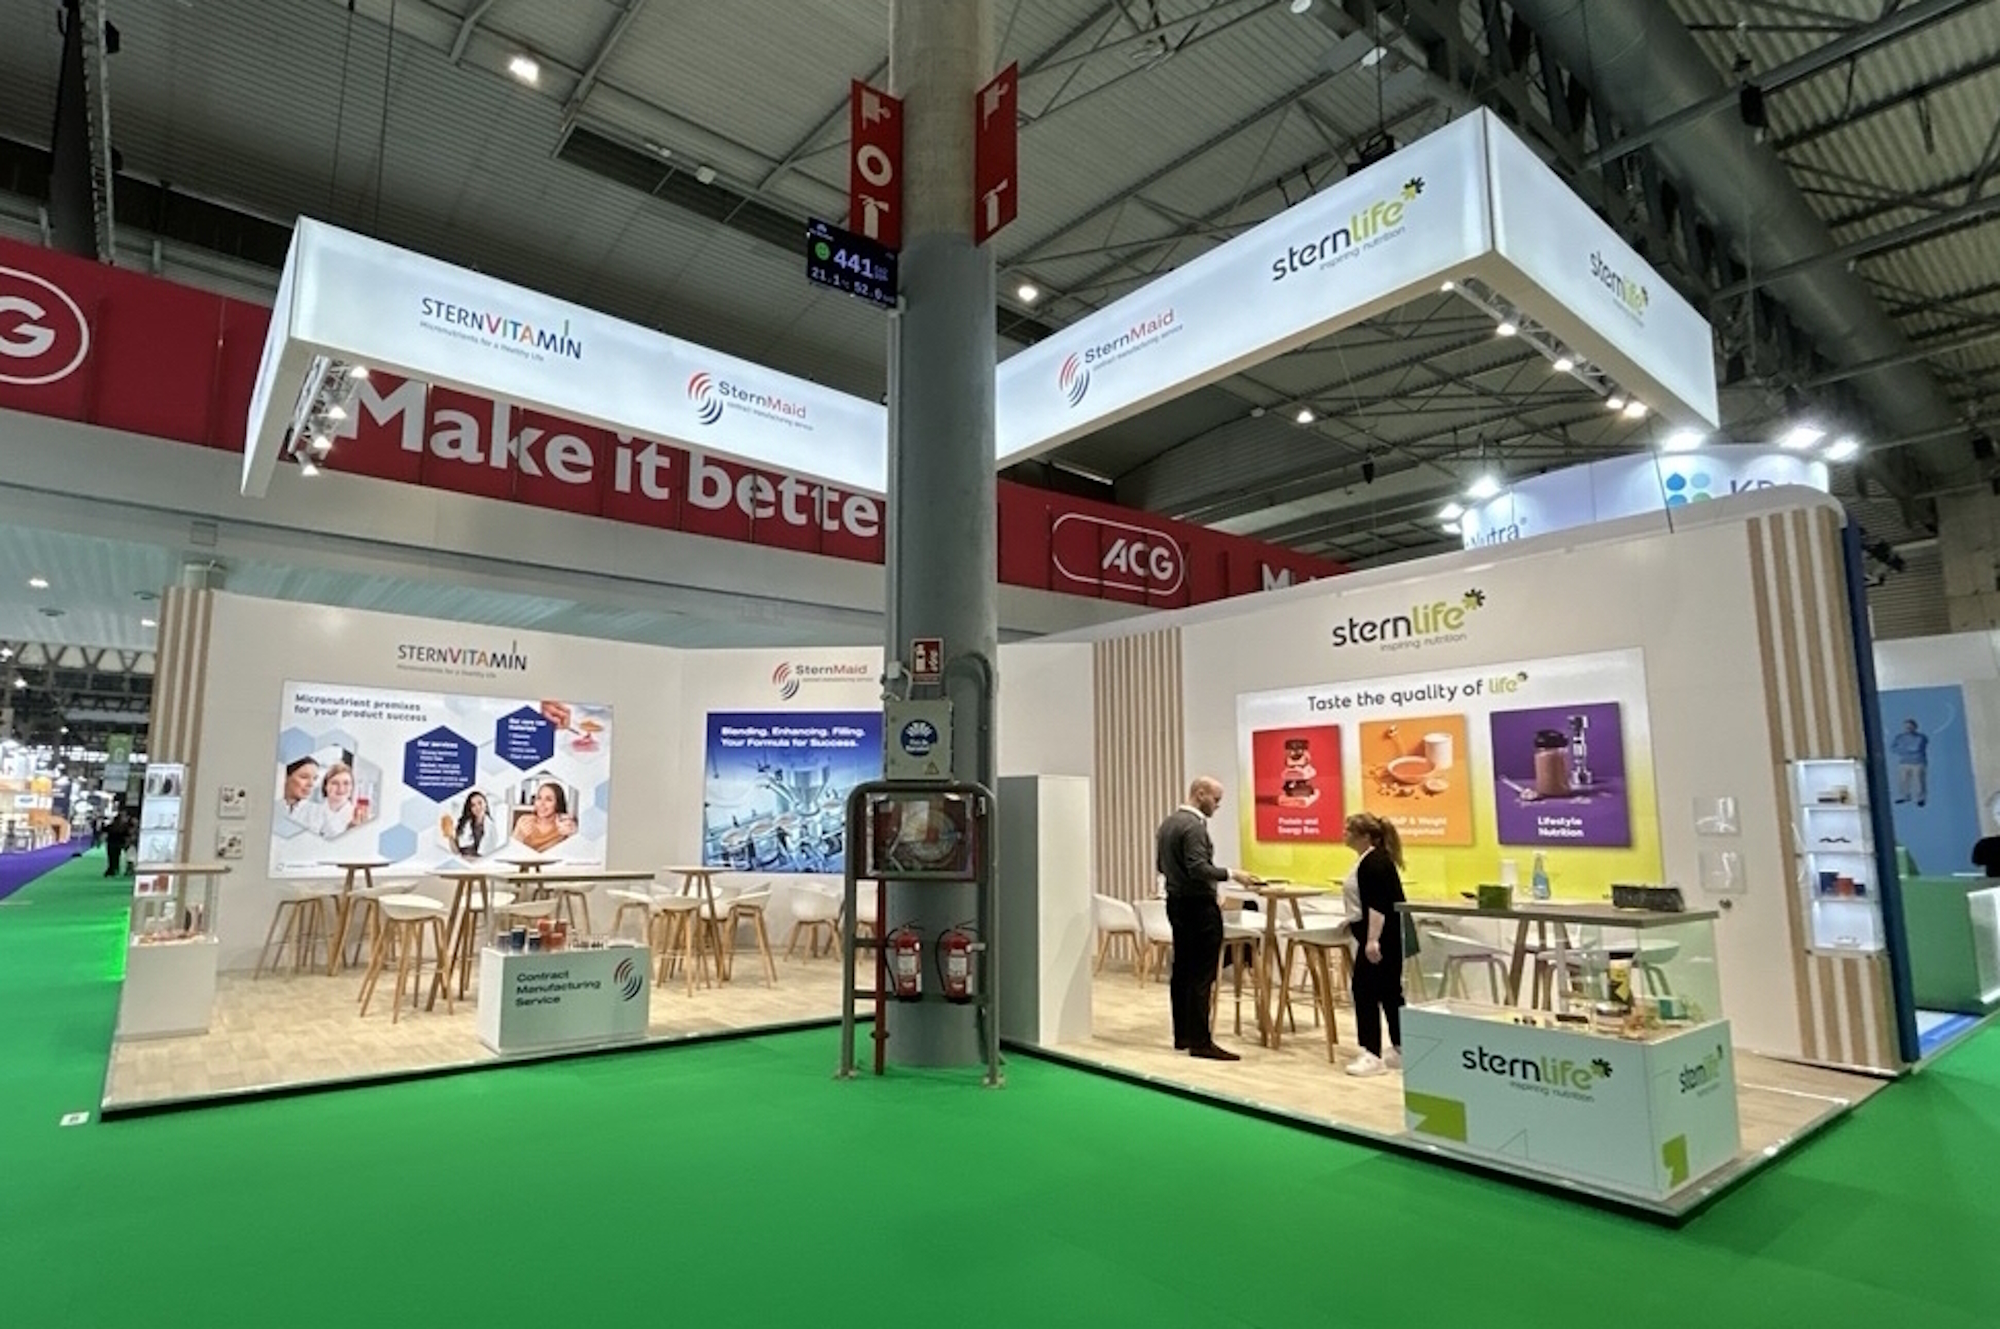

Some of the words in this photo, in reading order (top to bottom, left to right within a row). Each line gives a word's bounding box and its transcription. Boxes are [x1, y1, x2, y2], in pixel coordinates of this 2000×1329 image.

[1272, 200, 1404, 281] sternlife
[1319, 248, 1360, 270] inspiring
[1362, 226, 1405, 251] nutrition
[833, 248, 874, 279] 441
[421, 297, 582, 360] STERNVITAMIN
[1085, 307, 1174, 363] SternMaid
[718, 380, 807, 419] SternMaid
[335, 378, 593, 485] Make
[614, 434, 671, 500] it
[688, 451, 879, 538] bette
[1102, 538, 1174, 580] ACG
[1332, 601, 1464, 647] sternlife
[397, 640, 527, 671] STERNVITAMIN
[1379, 638, 1421, 652] inspiring
[1423, 632, 1467, 647] nutrition
[795, 664, 868, 675] SternMaid
[295, 693, 370, 707] Micronutrient
[373, 700, 421, 713] premixes
[1308, 695, 1351, 712] Taste
[1356, 691, 1385, 706] the
[1390, 683, 1459, 707] quality
[1462, 679, 1484, 696] of
[1488, 677, 1518, 695] life
[294, 704, 310, 714] for
[313, 707, 339, 718] your
[341, 706, 384, 720] product
[386, 711, 427, 722] success
[720, 738, 747, 747] Your
[747, 738, 790, 747] Formula
[792, 738, 808, 747] for
[1537, 816, 1583, 827] Lifestyle
[1537, 827, 1584, 838] Nutrition
[516, 970, 570, 983] Contract
[516, 980, 601, 995] Manufacturing
[515, 996, 561, 1008] Service
[1462, 1046, 1593, 1090] sternlife
